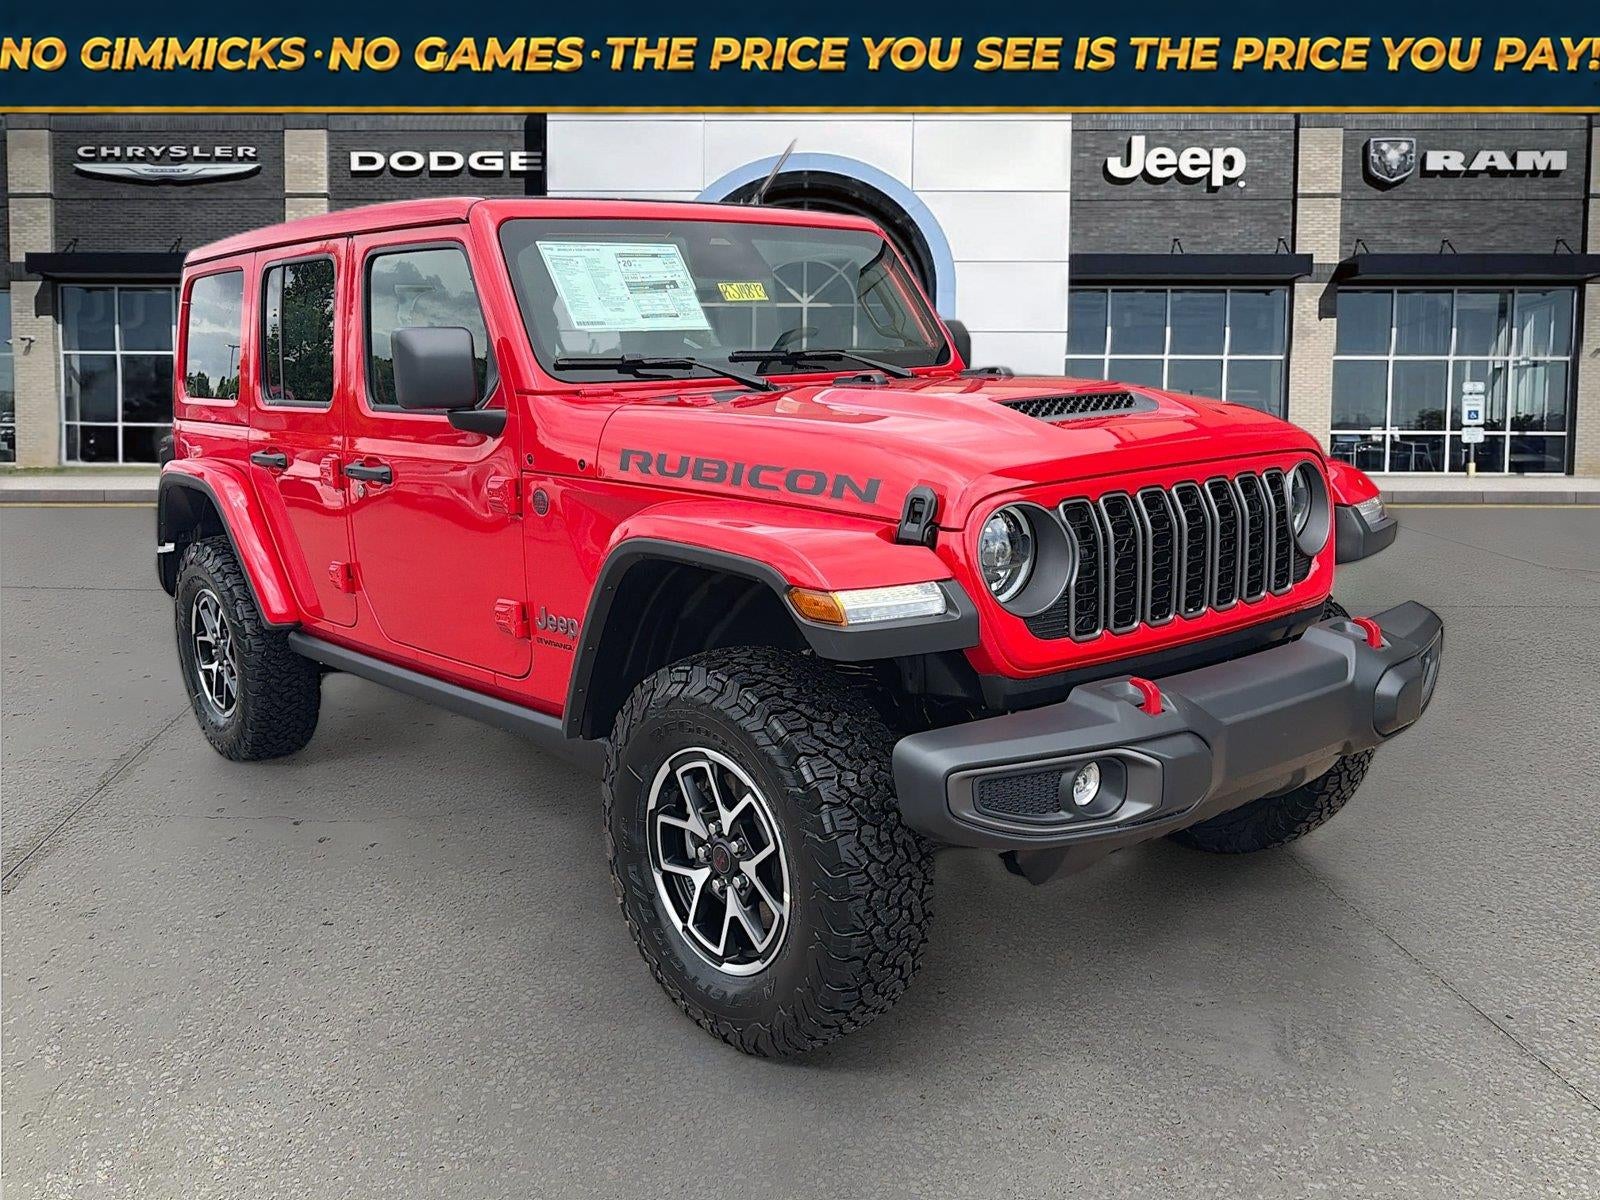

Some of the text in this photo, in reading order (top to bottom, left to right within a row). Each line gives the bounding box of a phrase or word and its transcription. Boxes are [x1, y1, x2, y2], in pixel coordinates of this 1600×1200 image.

[76, 145, 257, 158] CHRYSLER
[350, 151, 543, 172] DODGE
[1106, 134, 1247, 188] Jeep
[1425, 150, 1568, 171] RAM
[619, 448, 881, 504] RUBICON
[535, 606, 579, 641] Jeep
